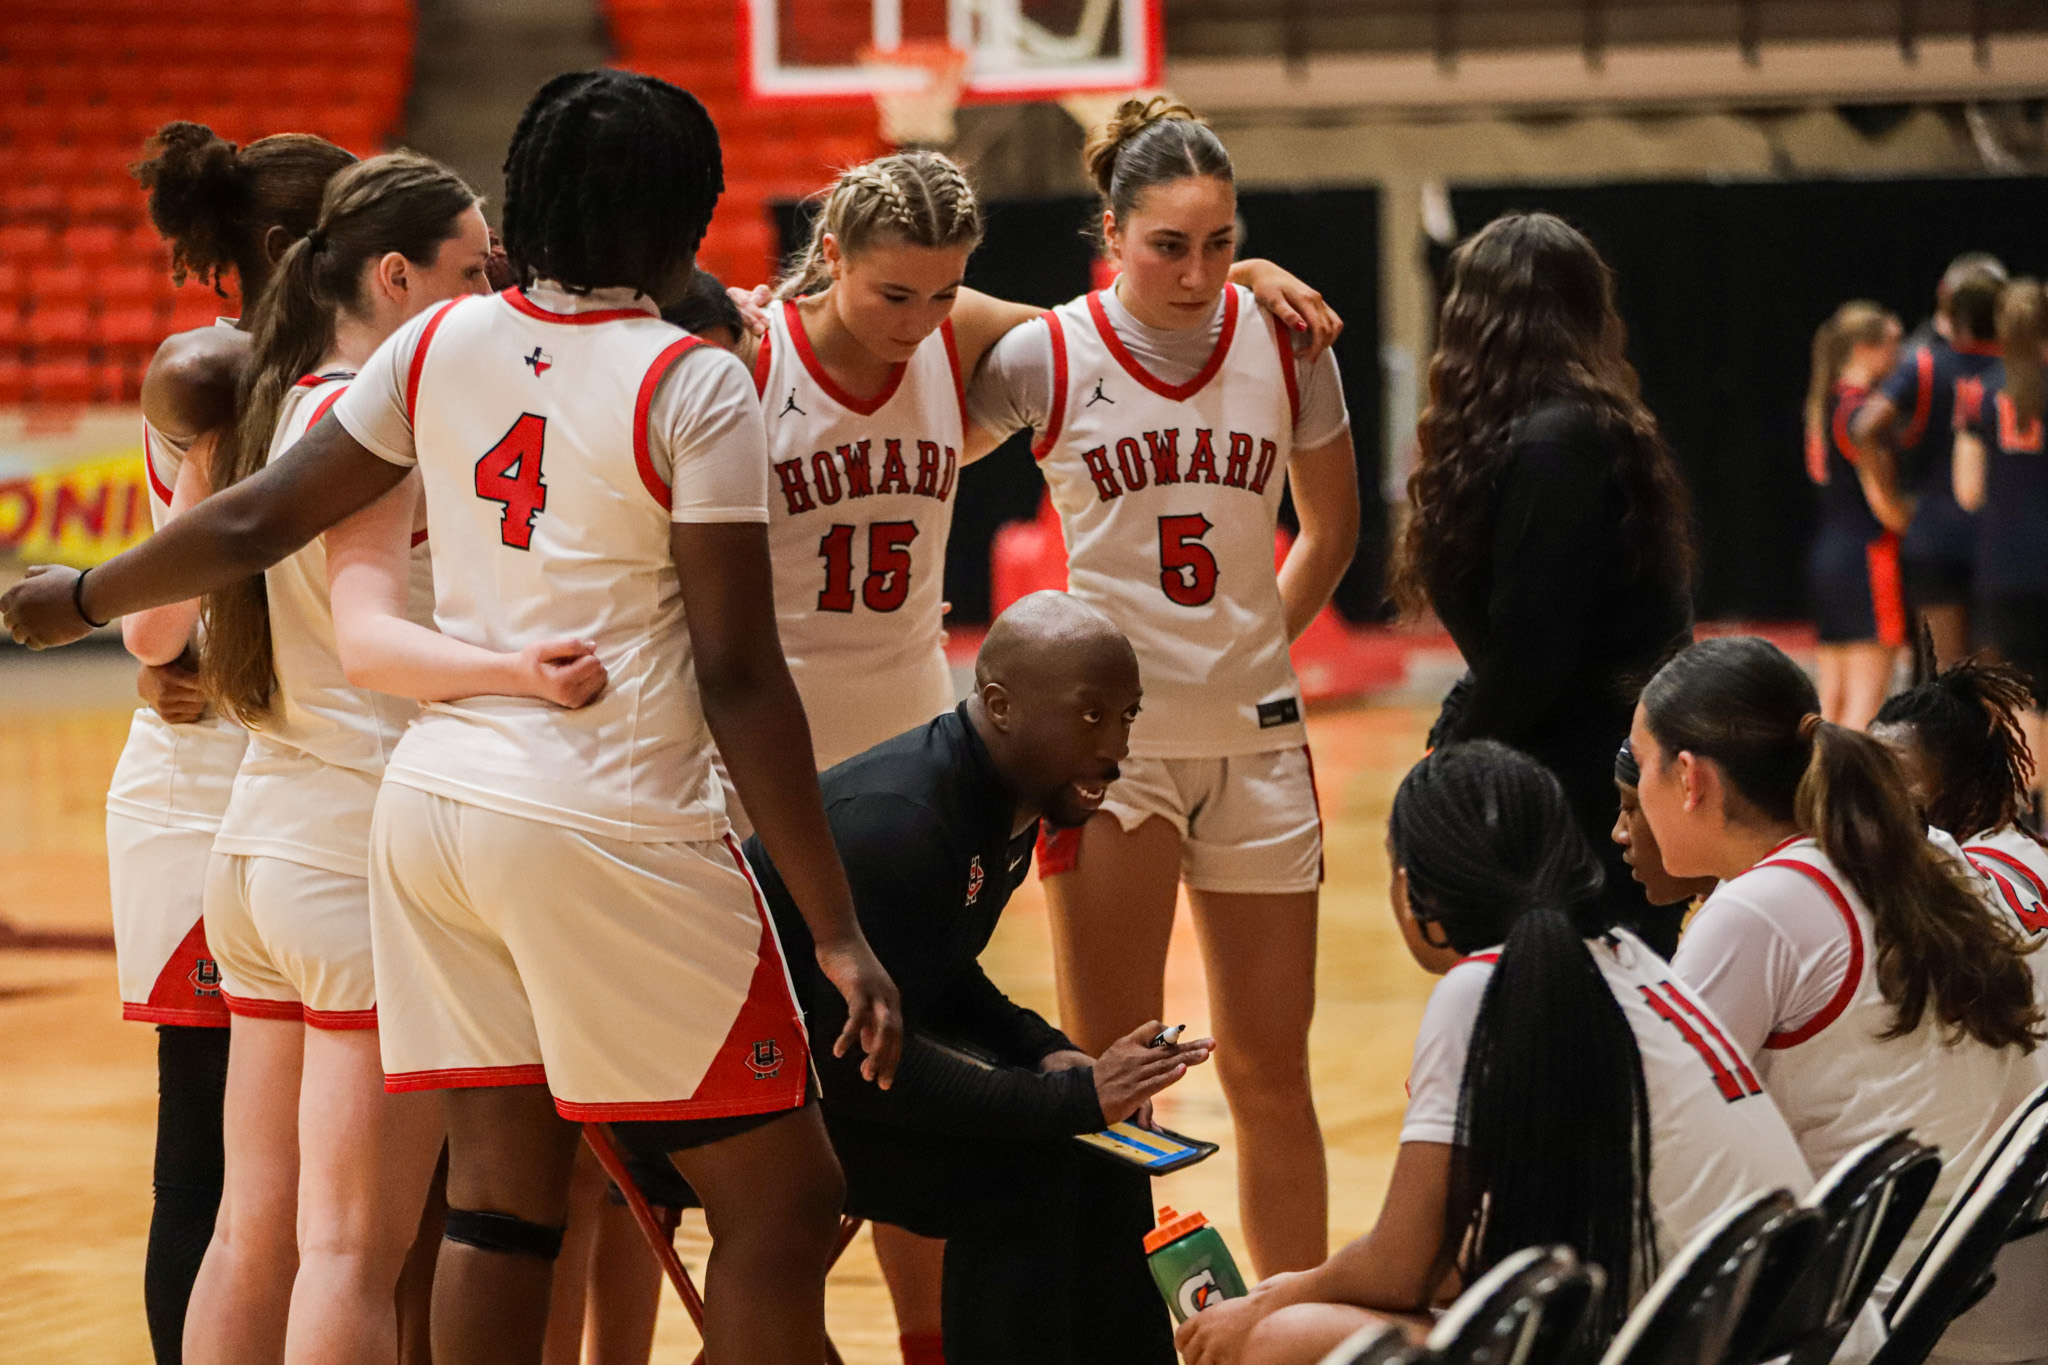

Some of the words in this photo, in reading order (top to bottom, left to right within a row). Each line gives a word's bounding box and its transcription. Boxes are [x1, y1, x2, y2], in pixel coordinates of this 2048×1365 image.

[474, 412, 547, 552] 4
[774, 439, 957, 515] HOWARD
[1082, 428, 1277, 502] HOWARD
[816, 520, 920, 613] 15
[1157, 512, 1220, 607] 5
[1637, 980, 1763, 1103] 11
